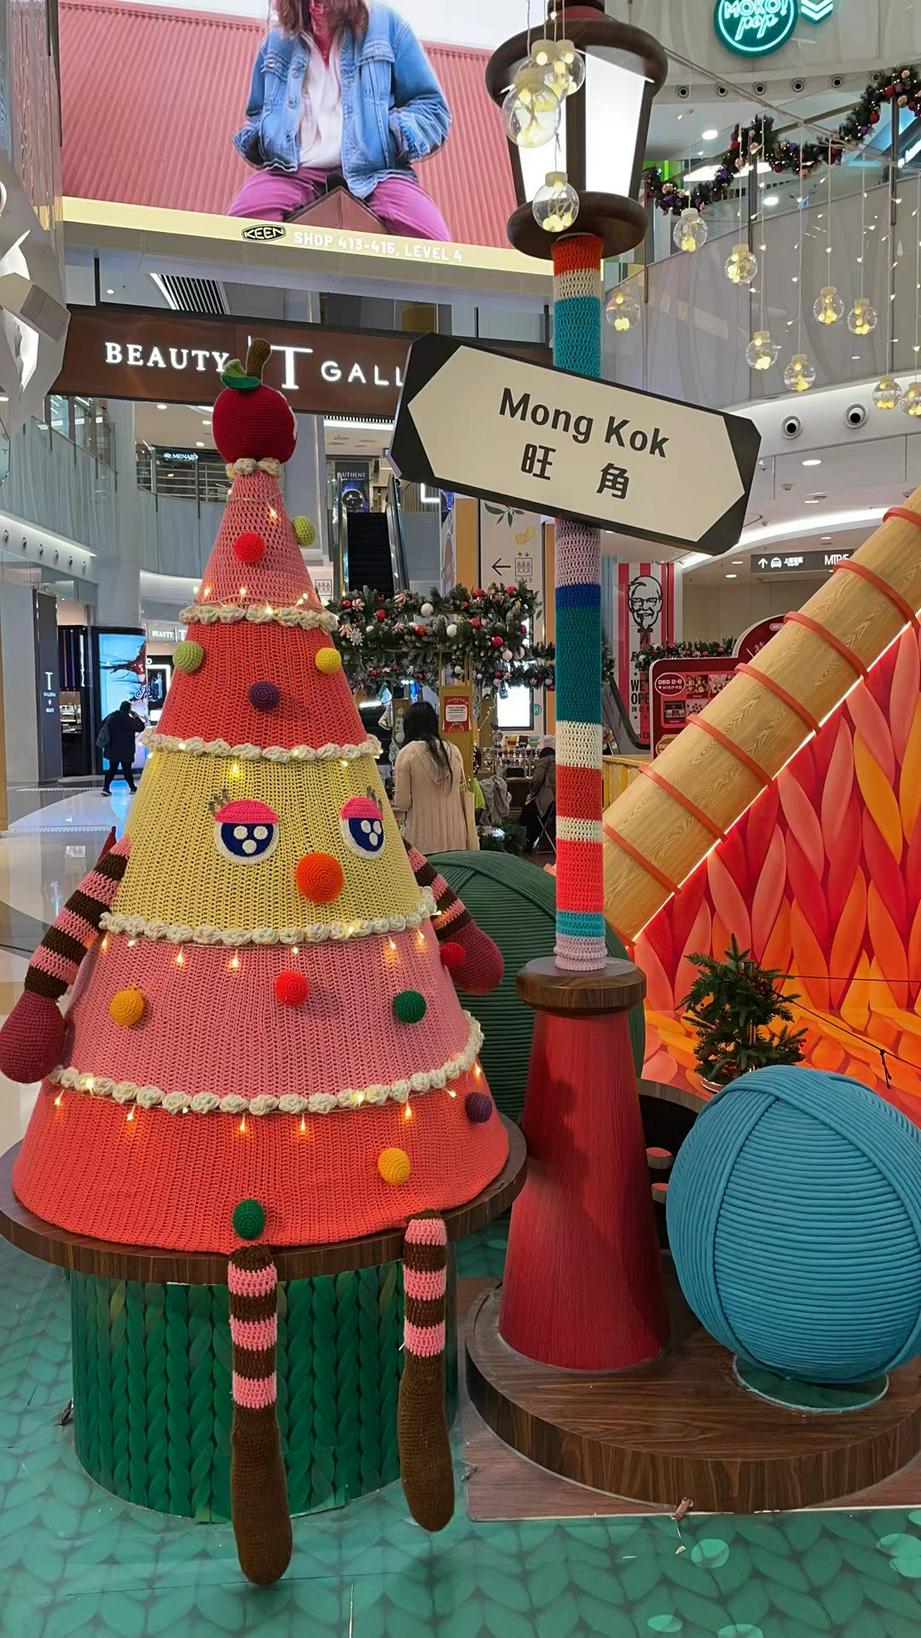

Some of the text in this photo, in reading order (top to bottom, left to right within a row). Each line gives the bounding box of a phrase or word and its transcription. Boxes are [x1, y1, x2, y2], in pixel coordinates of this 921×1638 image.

[724, 0, 789, 19] MOKO!
[735, 14, 779, 41] pop
[243, 226, 285, 240] KEEN
[294, 231, 463, 262] SHOP 413-415, LEVEL 4
[105, 342, 230, 372] BEAUTY
[270, 345, 404, 389] T GALL
[499, 387, 670, 459] Mong Kok
[520, 443, 630, 500] 旺角
